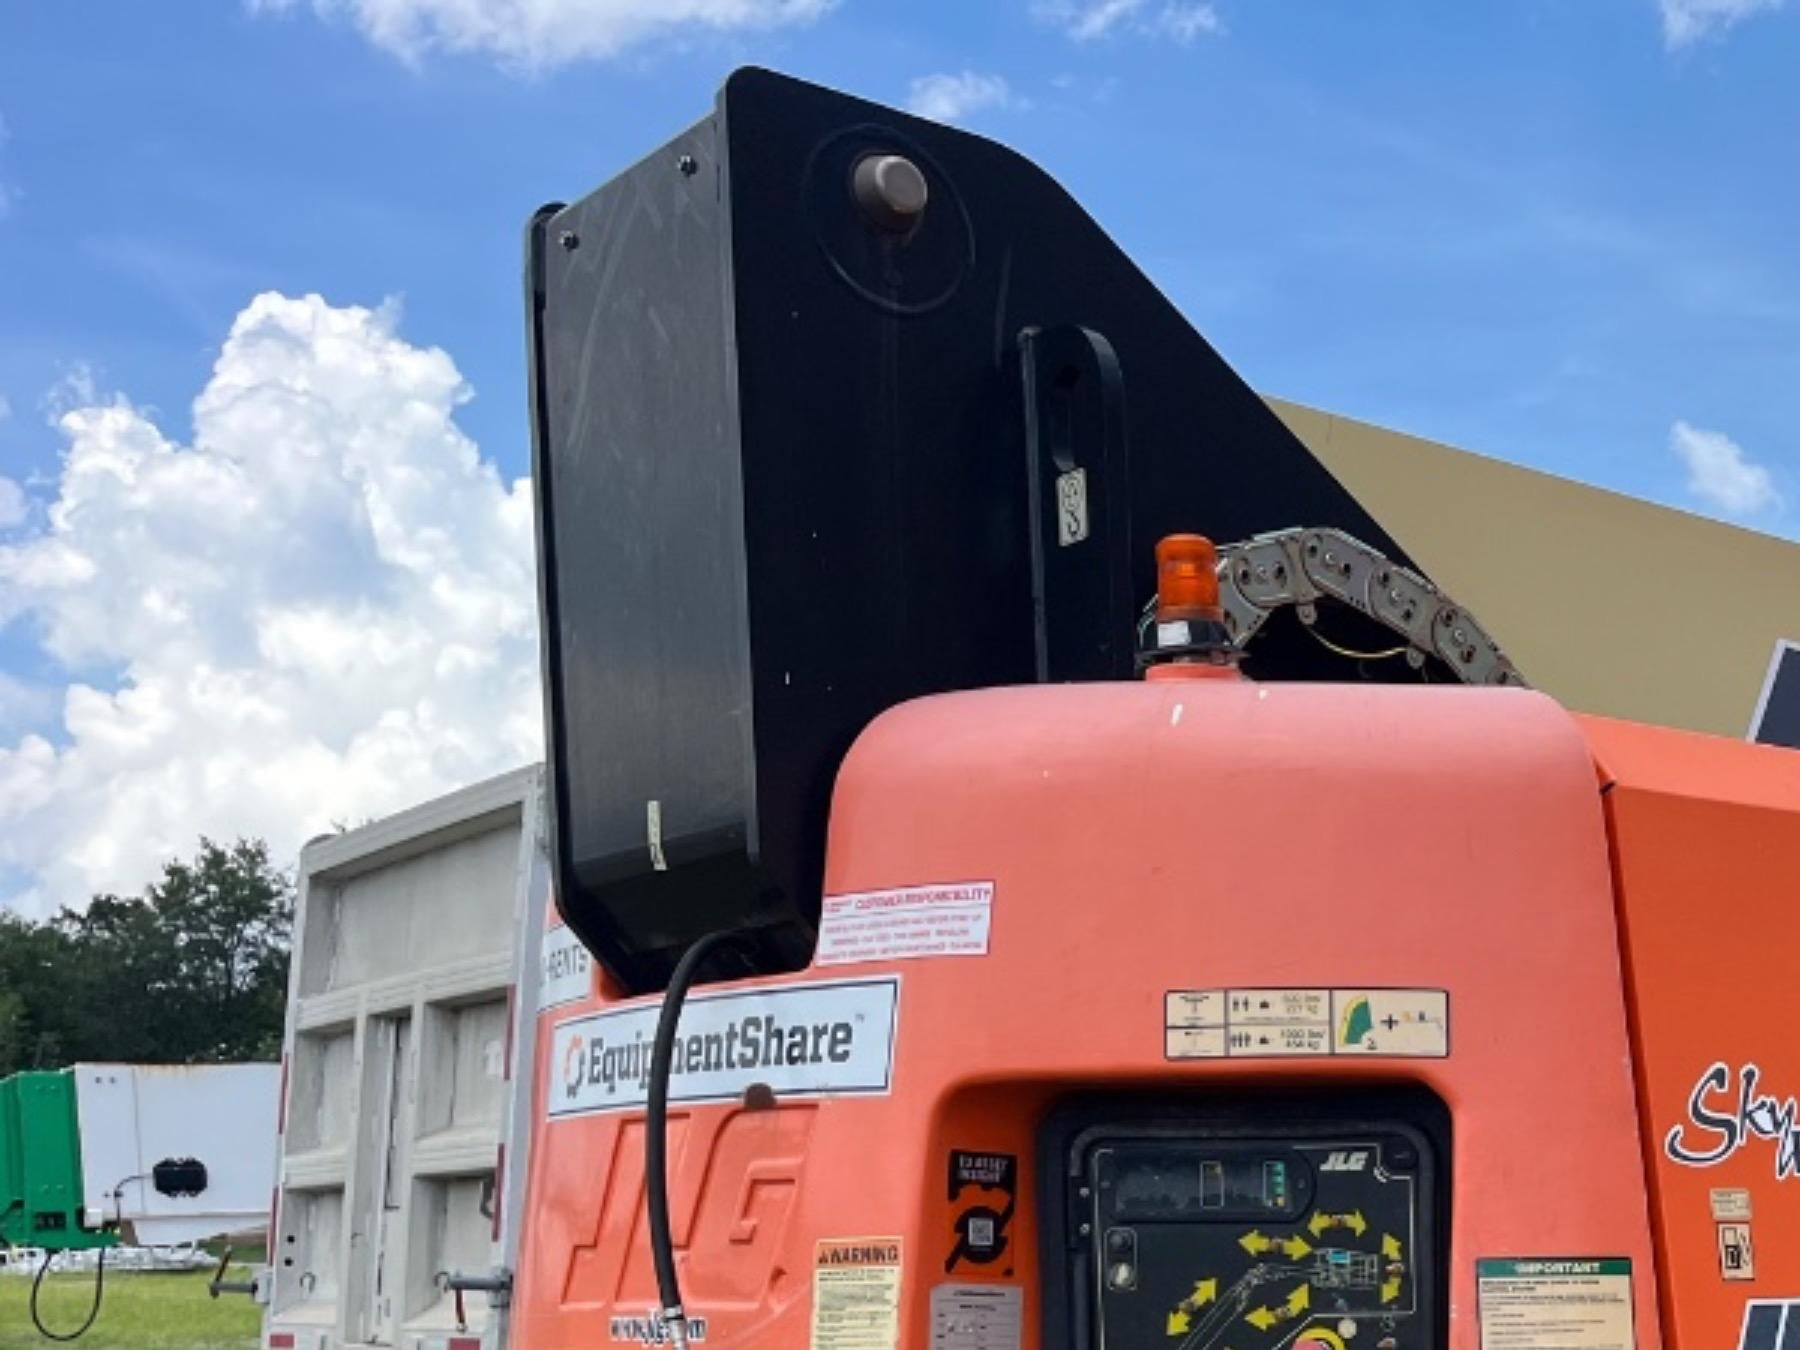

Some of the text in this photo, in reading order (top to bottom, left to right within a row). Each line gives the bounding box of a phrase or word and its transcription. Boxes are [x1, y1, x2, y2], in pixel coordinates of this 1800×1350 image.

[1669, 1064, 1794, 1178] Sky
[1319, 1151, 1369, 1172] JLG
[831, 1245, 898, 1264] WARNING
